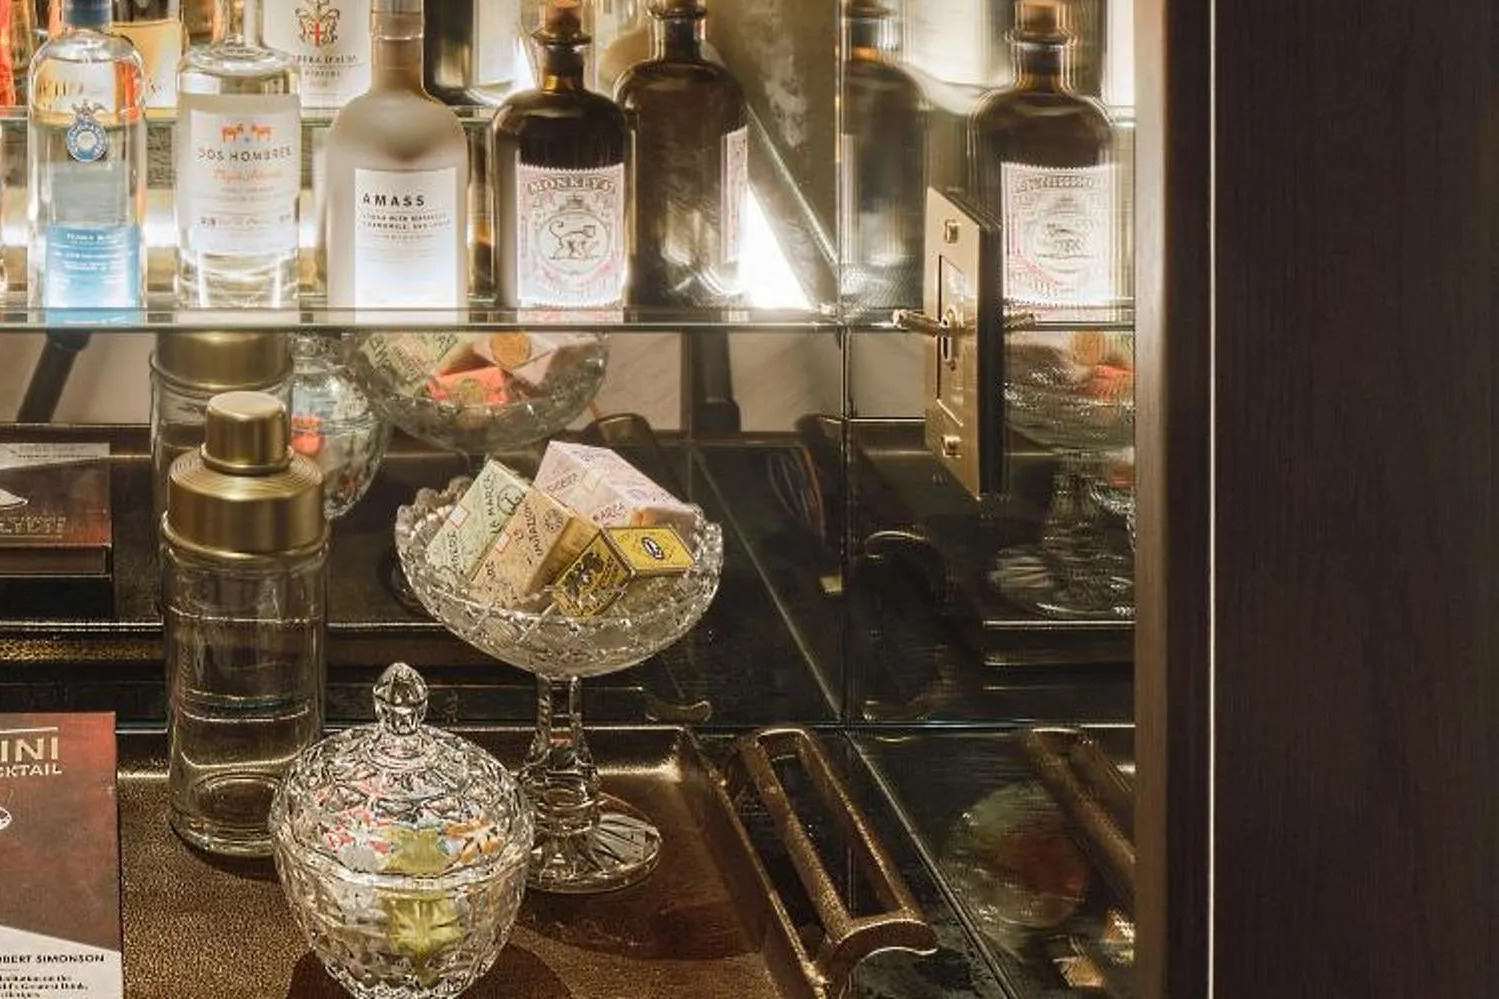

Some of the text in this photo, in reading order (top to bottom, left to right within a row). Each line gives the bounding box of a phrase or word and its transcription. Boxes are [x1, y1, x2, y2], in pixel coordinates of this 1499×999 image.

[229, 145, 291, 162] HOMBRES
[362, 193, 425, 207] AMASS
[36, 954, 105, 964] SIMONSON
